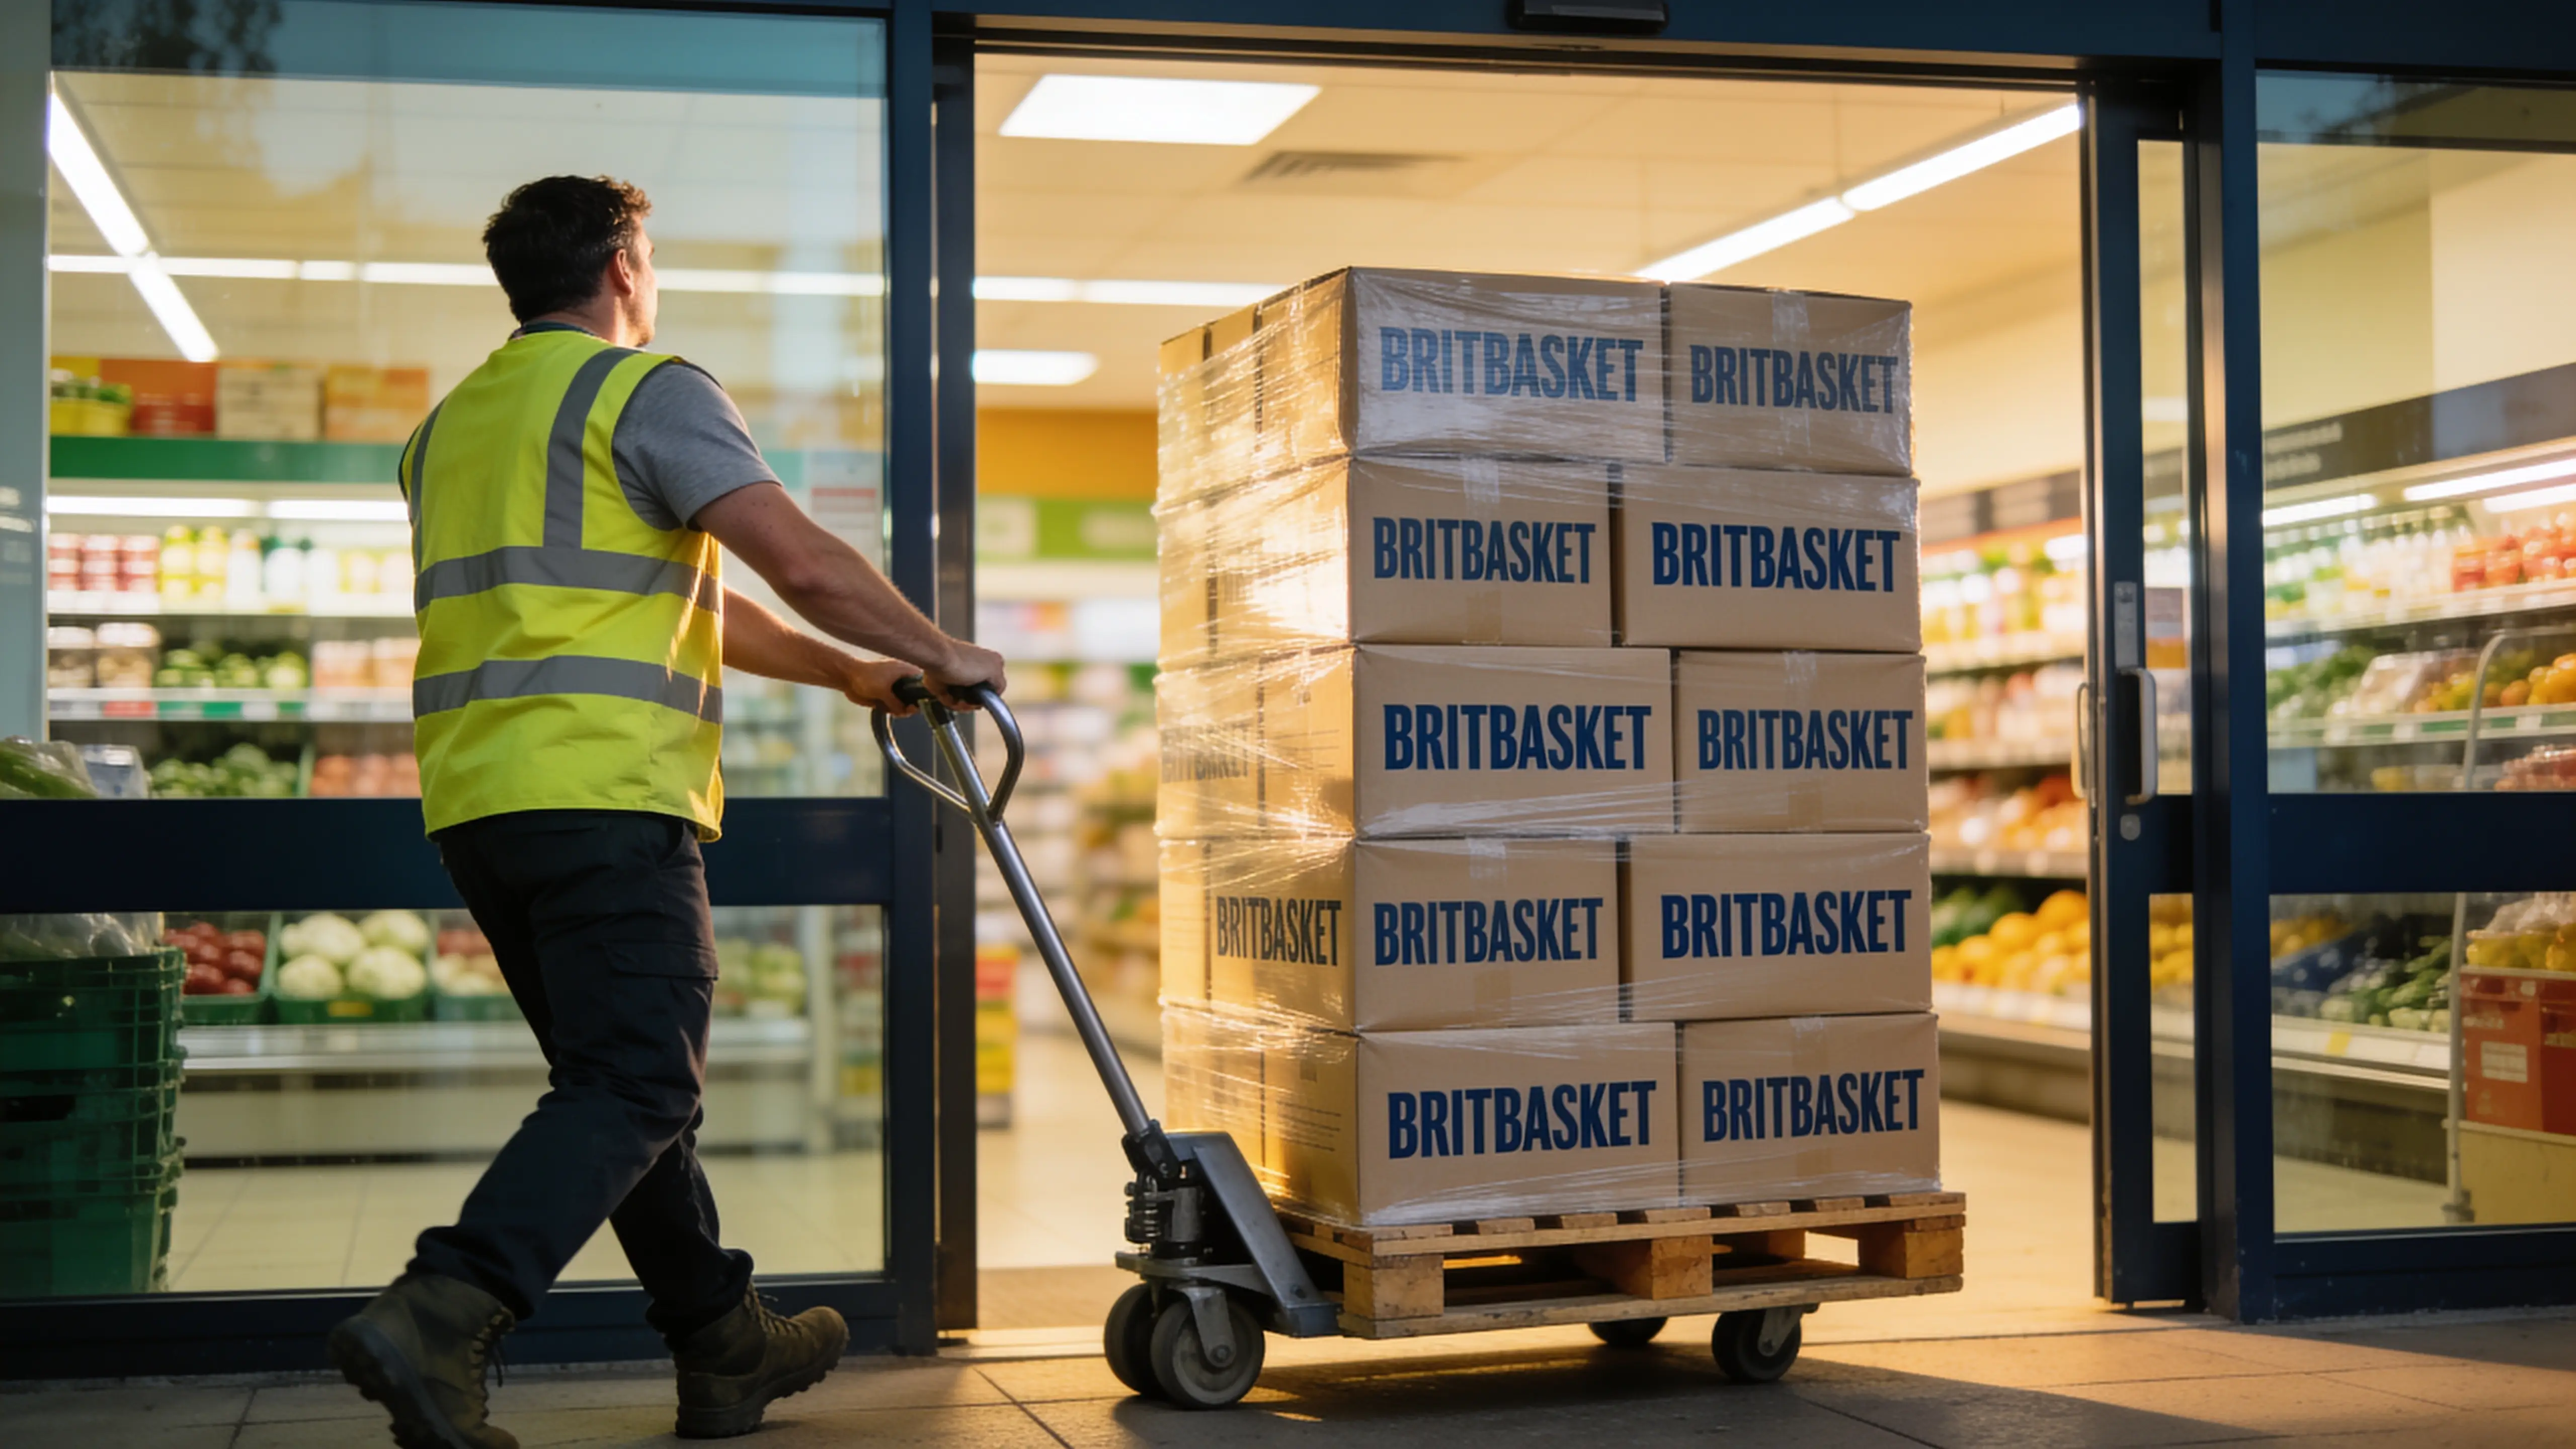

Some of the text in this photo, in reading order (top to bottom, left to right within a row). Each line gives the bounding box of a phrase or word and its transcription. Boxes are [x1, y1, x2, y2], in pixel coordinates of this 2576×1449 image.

[1380, 327, 1643, 401] BRITBASKET
[1690, 345, 1898, 413] BRITBASKET
[1373, 517, 1595, 584] BRITBASKET
[1652, 522, 1900, 592] BRITBASKET
[1384, 704, 1651, 770] BRITBASKET
[1698, 709, 1913, 770] BRITBASKET
[1217, 896, 1341, 967] BRITBASKET
[1374, 898, 1602, 965] BRITBASKET
[1661, 890, 1911, 959] BRITBASKET
[1388, 1081, 1656, 1159] BRITBASKET
[1703, 1069, 1924, 1142] BRITBASKET
